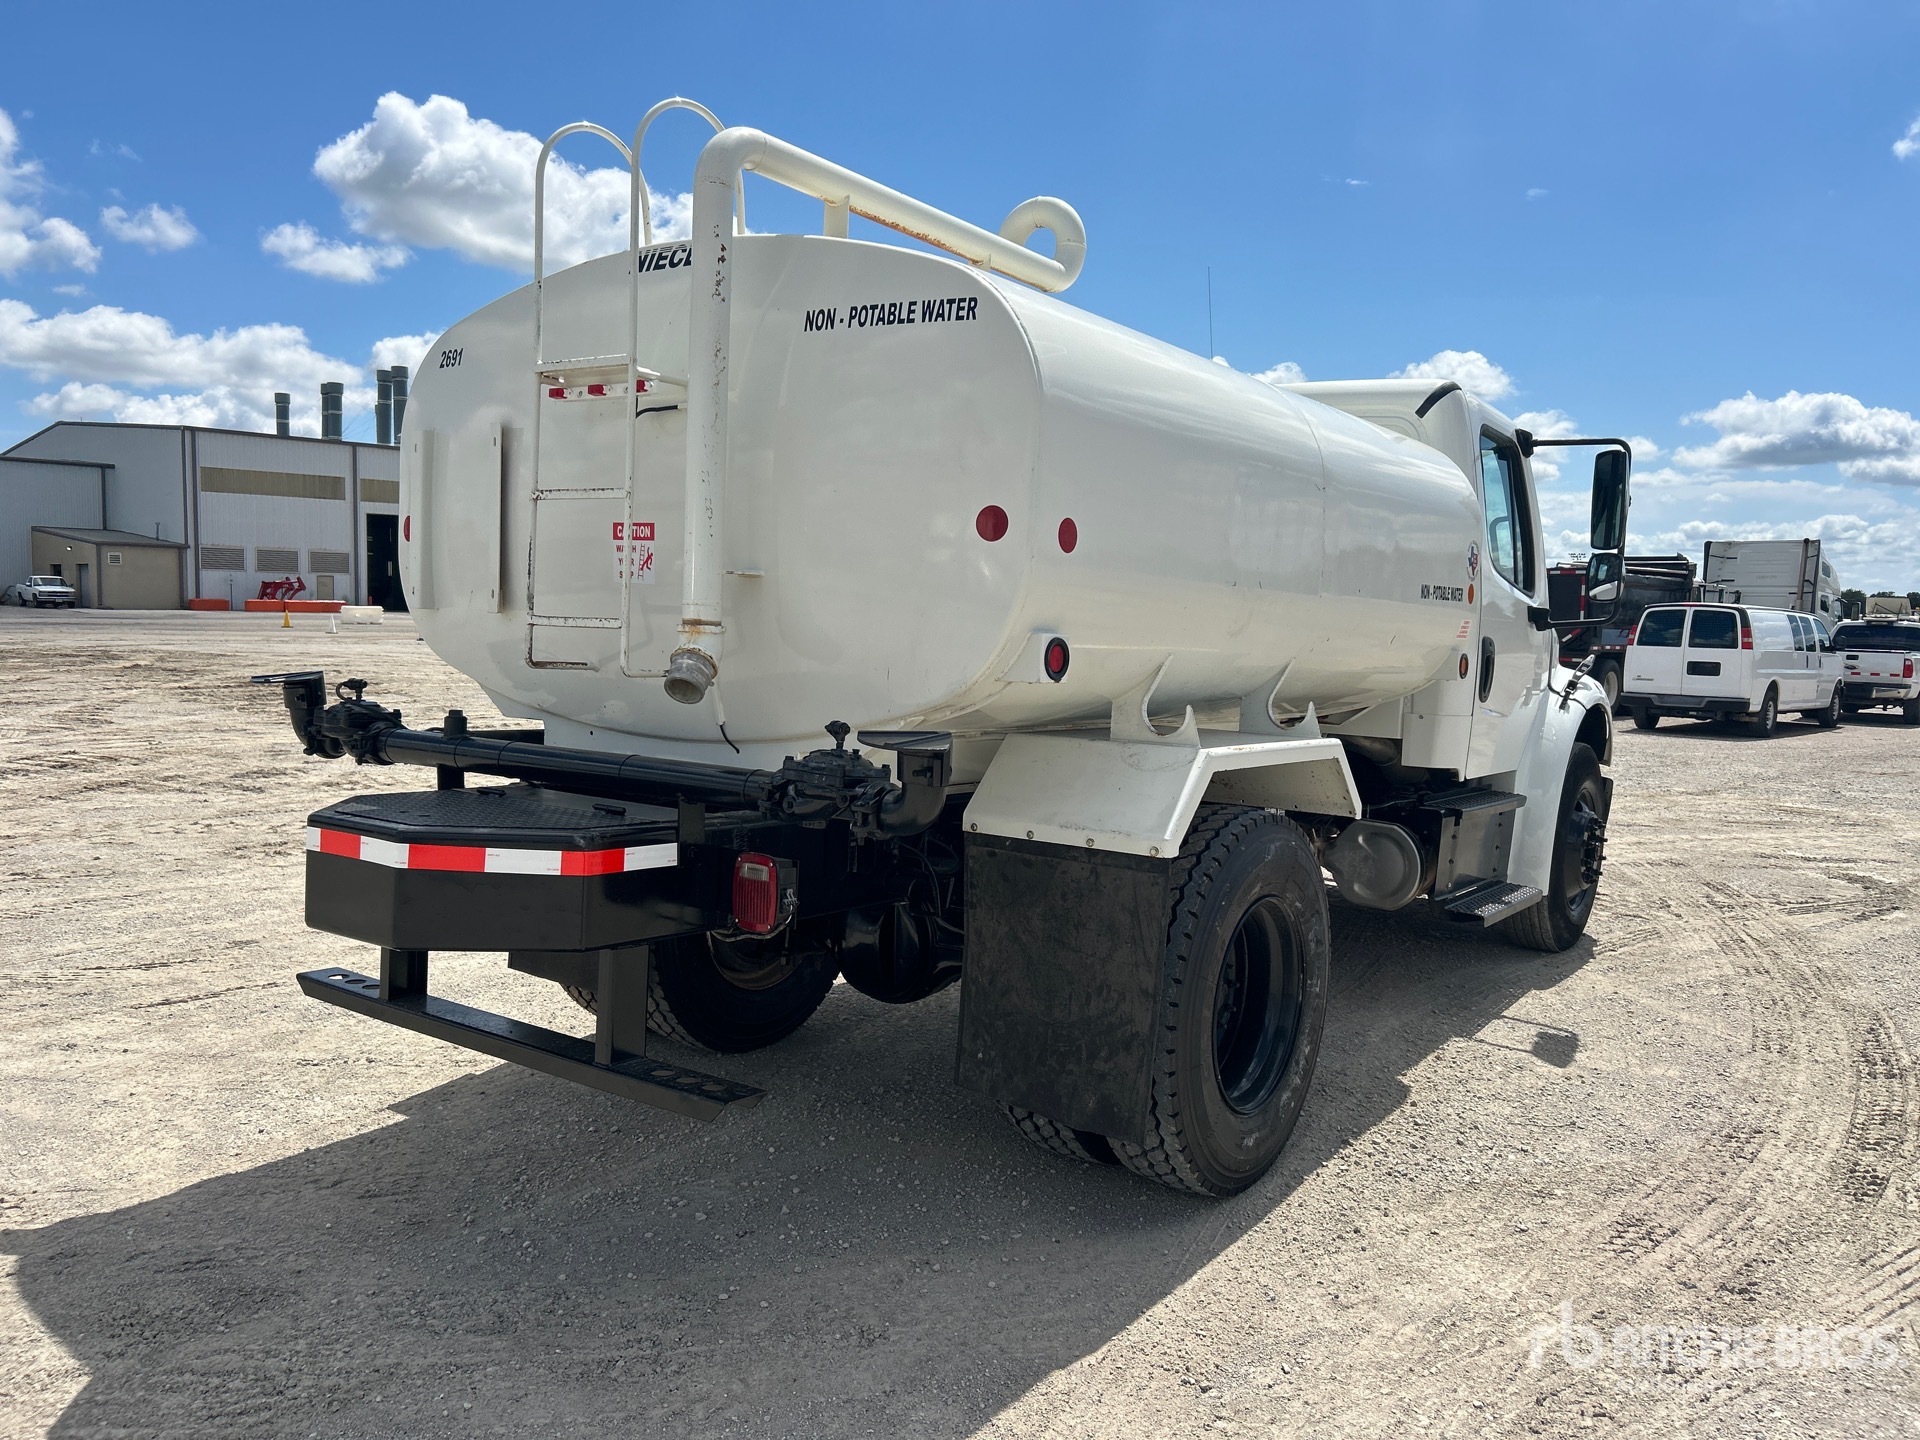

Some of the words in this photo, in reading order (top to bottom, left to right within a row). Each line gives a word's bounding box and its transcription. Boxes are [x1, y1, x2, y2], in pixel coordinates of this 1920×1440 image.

[804, 308, 837, 332] NON
[848, 301, 918, 329] POTABLE
[921, 297, 978, 323] WATER
[439, 347, 464, 369] 2691
[617, 526, 650, 537] CTION
[618, 558, 634, 566] YR
[1421, 584, 1431, 599] NON
[1433, 585, 1450, 601] POTABLE
[1451, 587, 1463, 601] WATER
